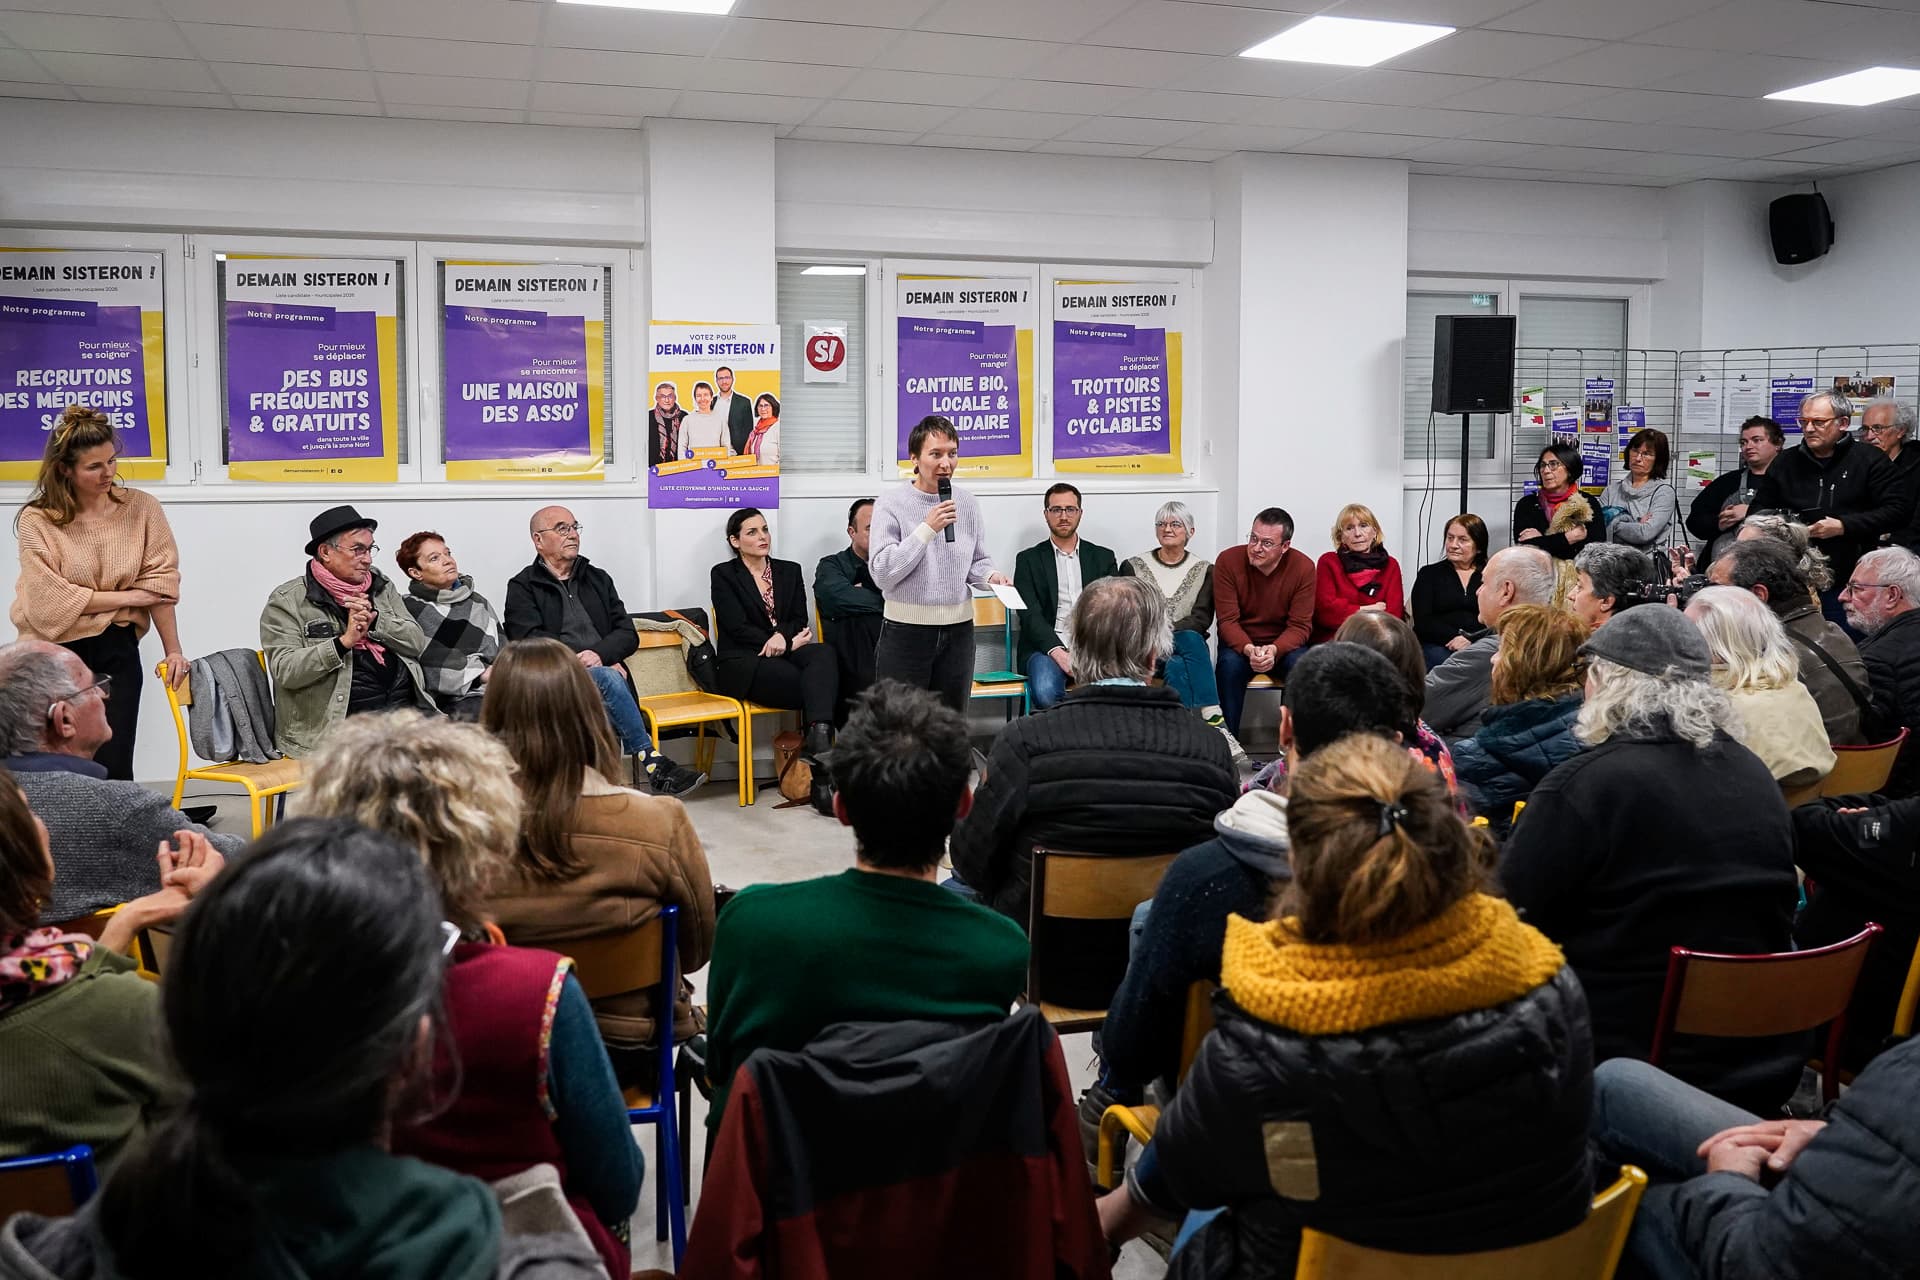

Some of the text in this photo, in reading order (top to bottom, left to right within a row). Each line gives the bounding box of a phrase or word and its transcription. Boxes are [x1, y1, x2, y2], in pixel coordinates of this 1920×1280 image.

[0, 266, 156, 280] EMAIN SISTERON !
[237, 272, 390, 287] DEMAIN SISTERON !
[455, 278, 598, 292] DEMAIN SISTERON !
[906, 290, 1028, 304] DEMAIN SISTERON !
[1062, 294, 1177, 308] DEMAIN SISTERON !
[3, 305, 86, 317] Notre programme
[247, 310, 325, 322] Notre programme
[464, 314, 537, 326] Notre programme
[936, 326, 976, 335] programme
[1069, 328, 1127, 338] Notre programme
[80, 341, 130, 350] Pour mieux
[318, 342, 366, 351] Pour mieux
[656, 343, 775, 355] DEMAIN SISTERON !
[95, 350, 130, 360] soigner
[326, 352, 367, 362] déplacer
[532, 358, 577, 366] Pour mieux
[1123, 354, 1159, 363] Pour mieux
[532, 368, 577, 376] rencontrer
[980, 361, 1008, 369] manger
[1129, 363, 1160, 372] déplacer
[16, 368, 132, 387] RECRUTONS
[283, 368, 368, 388] DES BUS
[906, 375, 1008, 393] CANTINE BIO,
[462, 382, 578, 401] UNE MAISON
[1072, 377, 1160, 396] TROTTOIRS
[0, 387, 134, 409] ES MÉDECINS
[250, 388, 369, 410] FRÉQUENTS
[932, 395, 1009, 412] LOCALE &
[1087, 396, 1161, 414] & PISTES
[482, 405, 519, 423] DES
[249, 413, 370, 433] & GRATUITS
[1067, 415, 1162, 435] CYCLABLES
